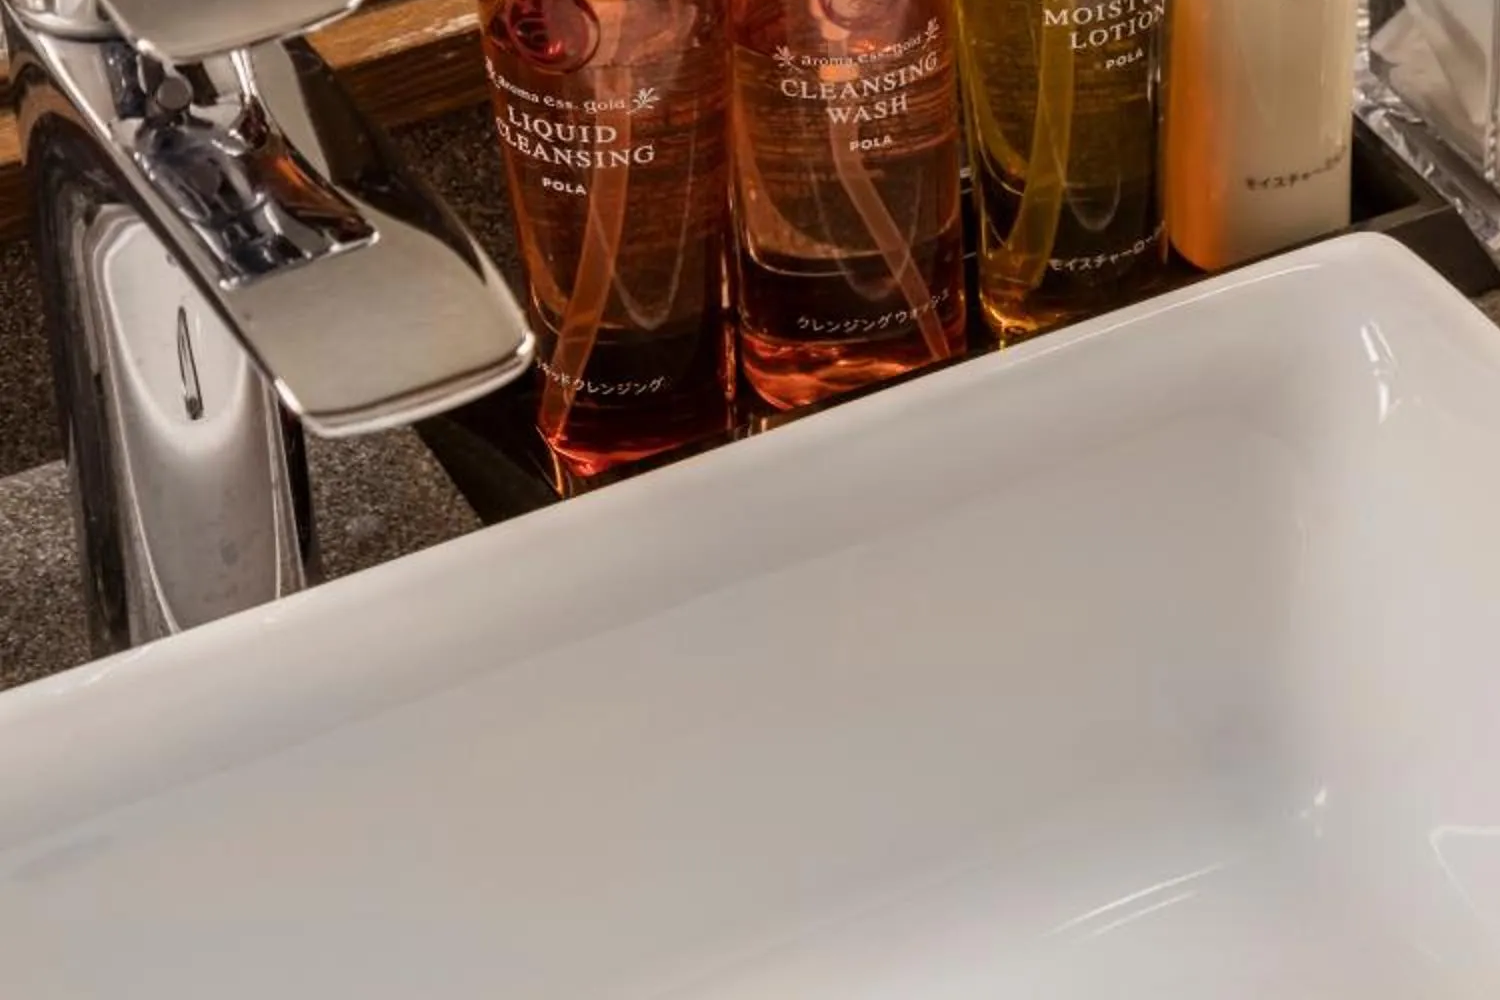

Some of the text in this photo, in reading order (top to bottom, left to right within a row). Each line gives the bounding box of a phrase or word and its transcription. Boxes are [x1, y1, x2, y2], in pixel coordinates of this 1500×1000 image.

[1070, 0, 1166, 50] LOTION
[780, 51, 939, 99] CLEANSING
[1106, 47, 1144, 70] POLA
[507, 104, 617, 143] LIQUID
[584, 99, 626, 115] gold
[826, 92, 909, 125] WASH
[495, 116, 655, 169] CLEANSING
[850, 134, 893, 151] POLA
[542, 176, 588, 196] POLA
